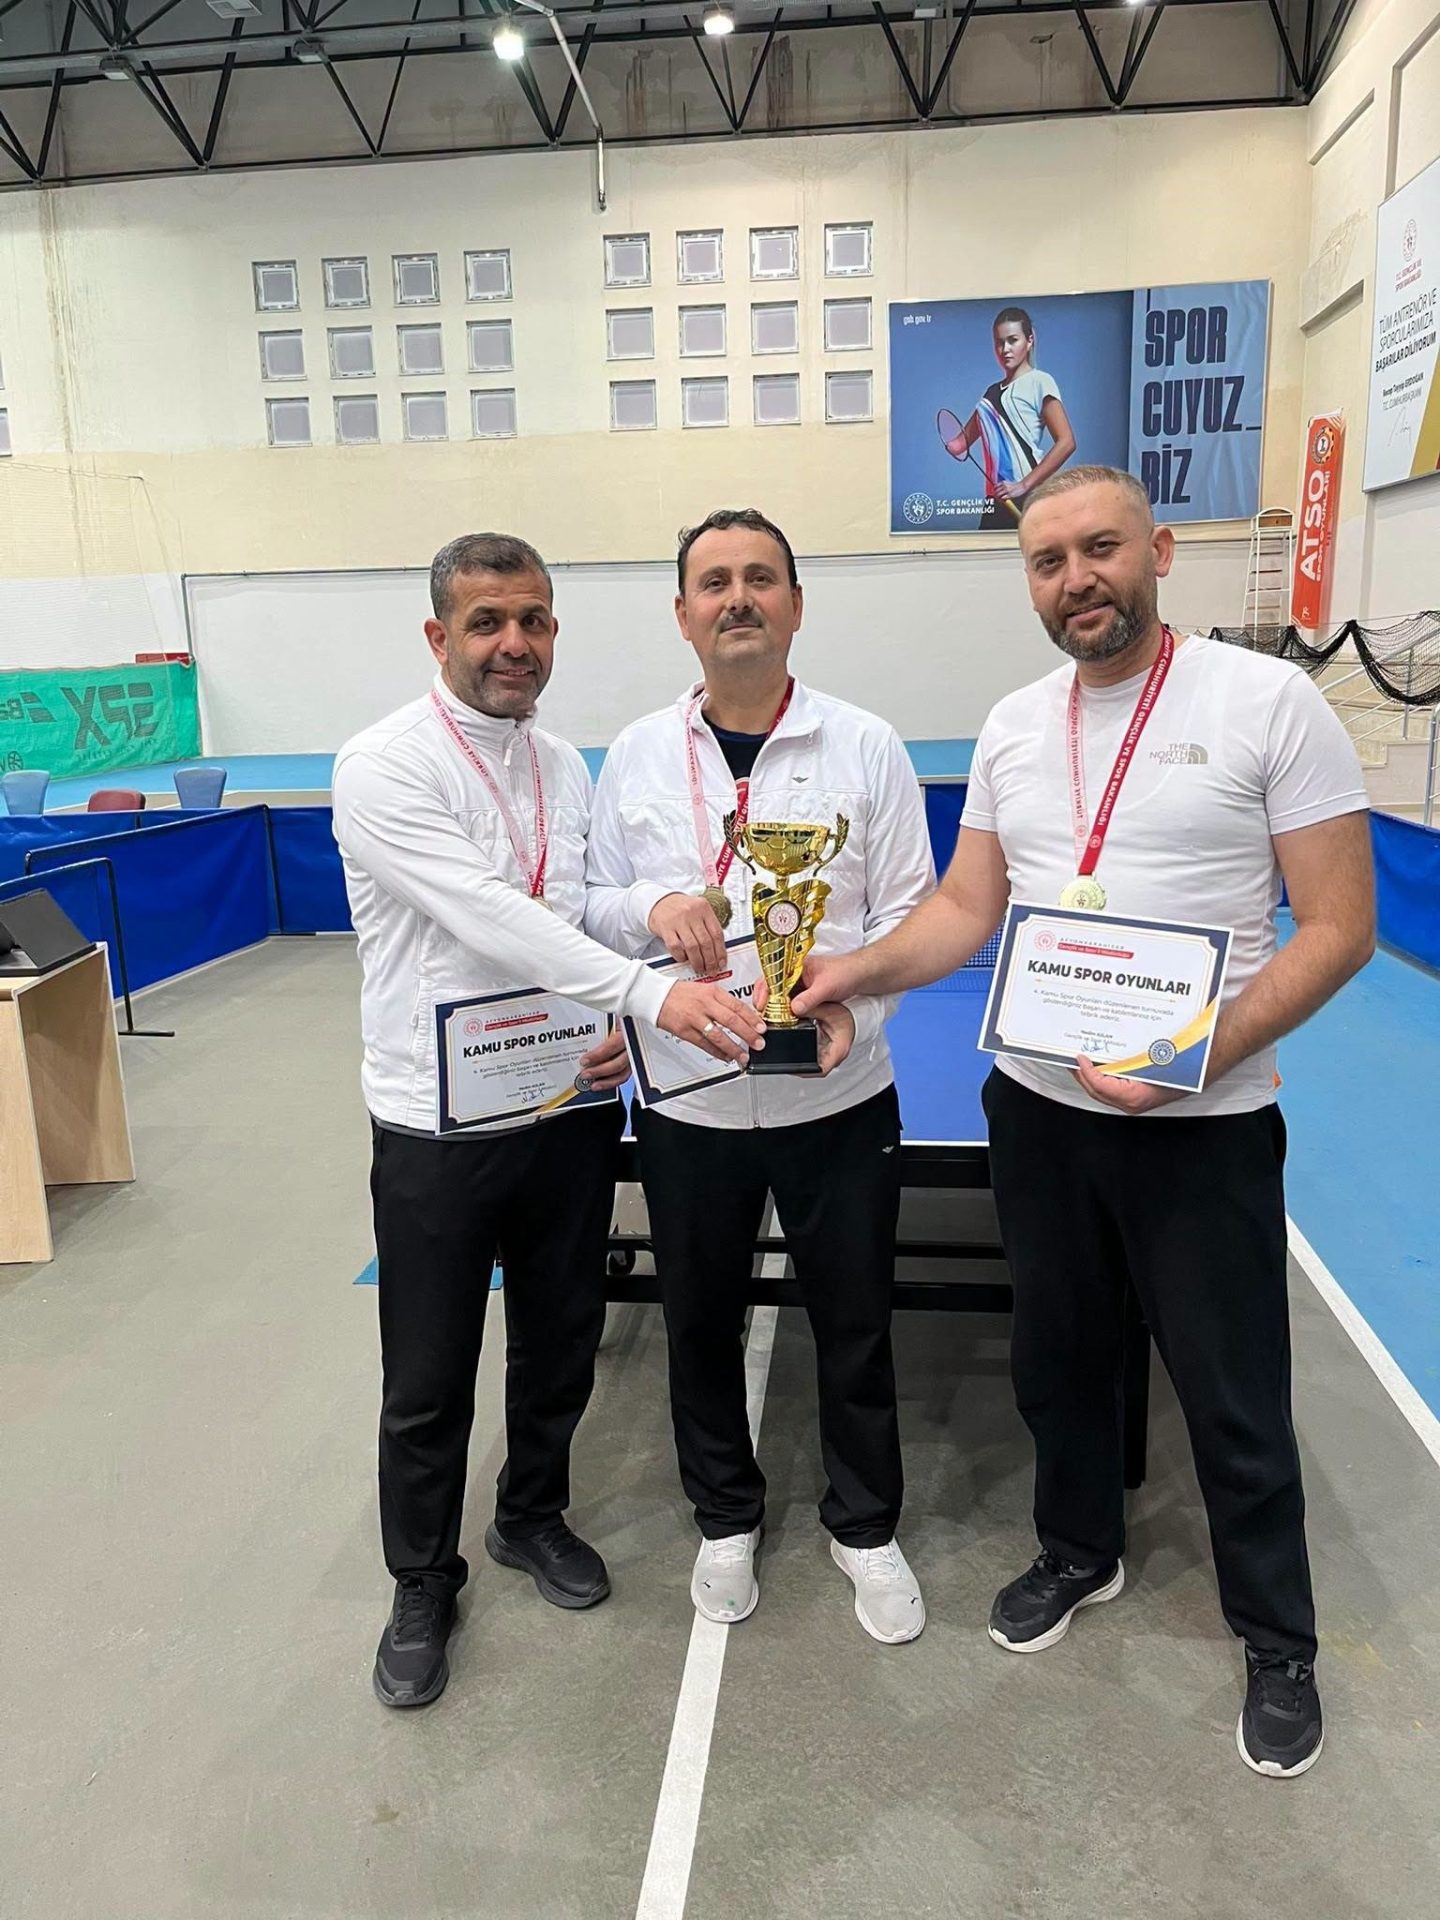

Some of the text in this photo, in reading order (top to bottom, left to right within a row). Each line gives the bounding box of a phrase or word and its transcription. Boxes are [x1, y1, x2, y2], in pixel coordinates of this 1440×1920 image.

[1380, 314, 1394, 335] TÜM
[1393, 292, 1428, 328] ANTRENÖR
[1380, 310, 1434, 354] SPORCULARIMIZA
[1145, 306, 1228, 368] SPOR
[1375, 330, 1437, 374] BAŞARILAR DİLİYORUM
[1141, 445, 1193, 506] BİZ
[1300, 469, 1325, 581] ATSO
[1150, 750, 1188, 759] NORTH
[1160, 757, 1187, 765] FACE
[1169, 743, 1188, 751] THE
[1027, 960, 1191, 996] KAMU SPOR OYUNLARI
[463, 1023, 596, 1058] KAMU SPOR OYUNLARI
